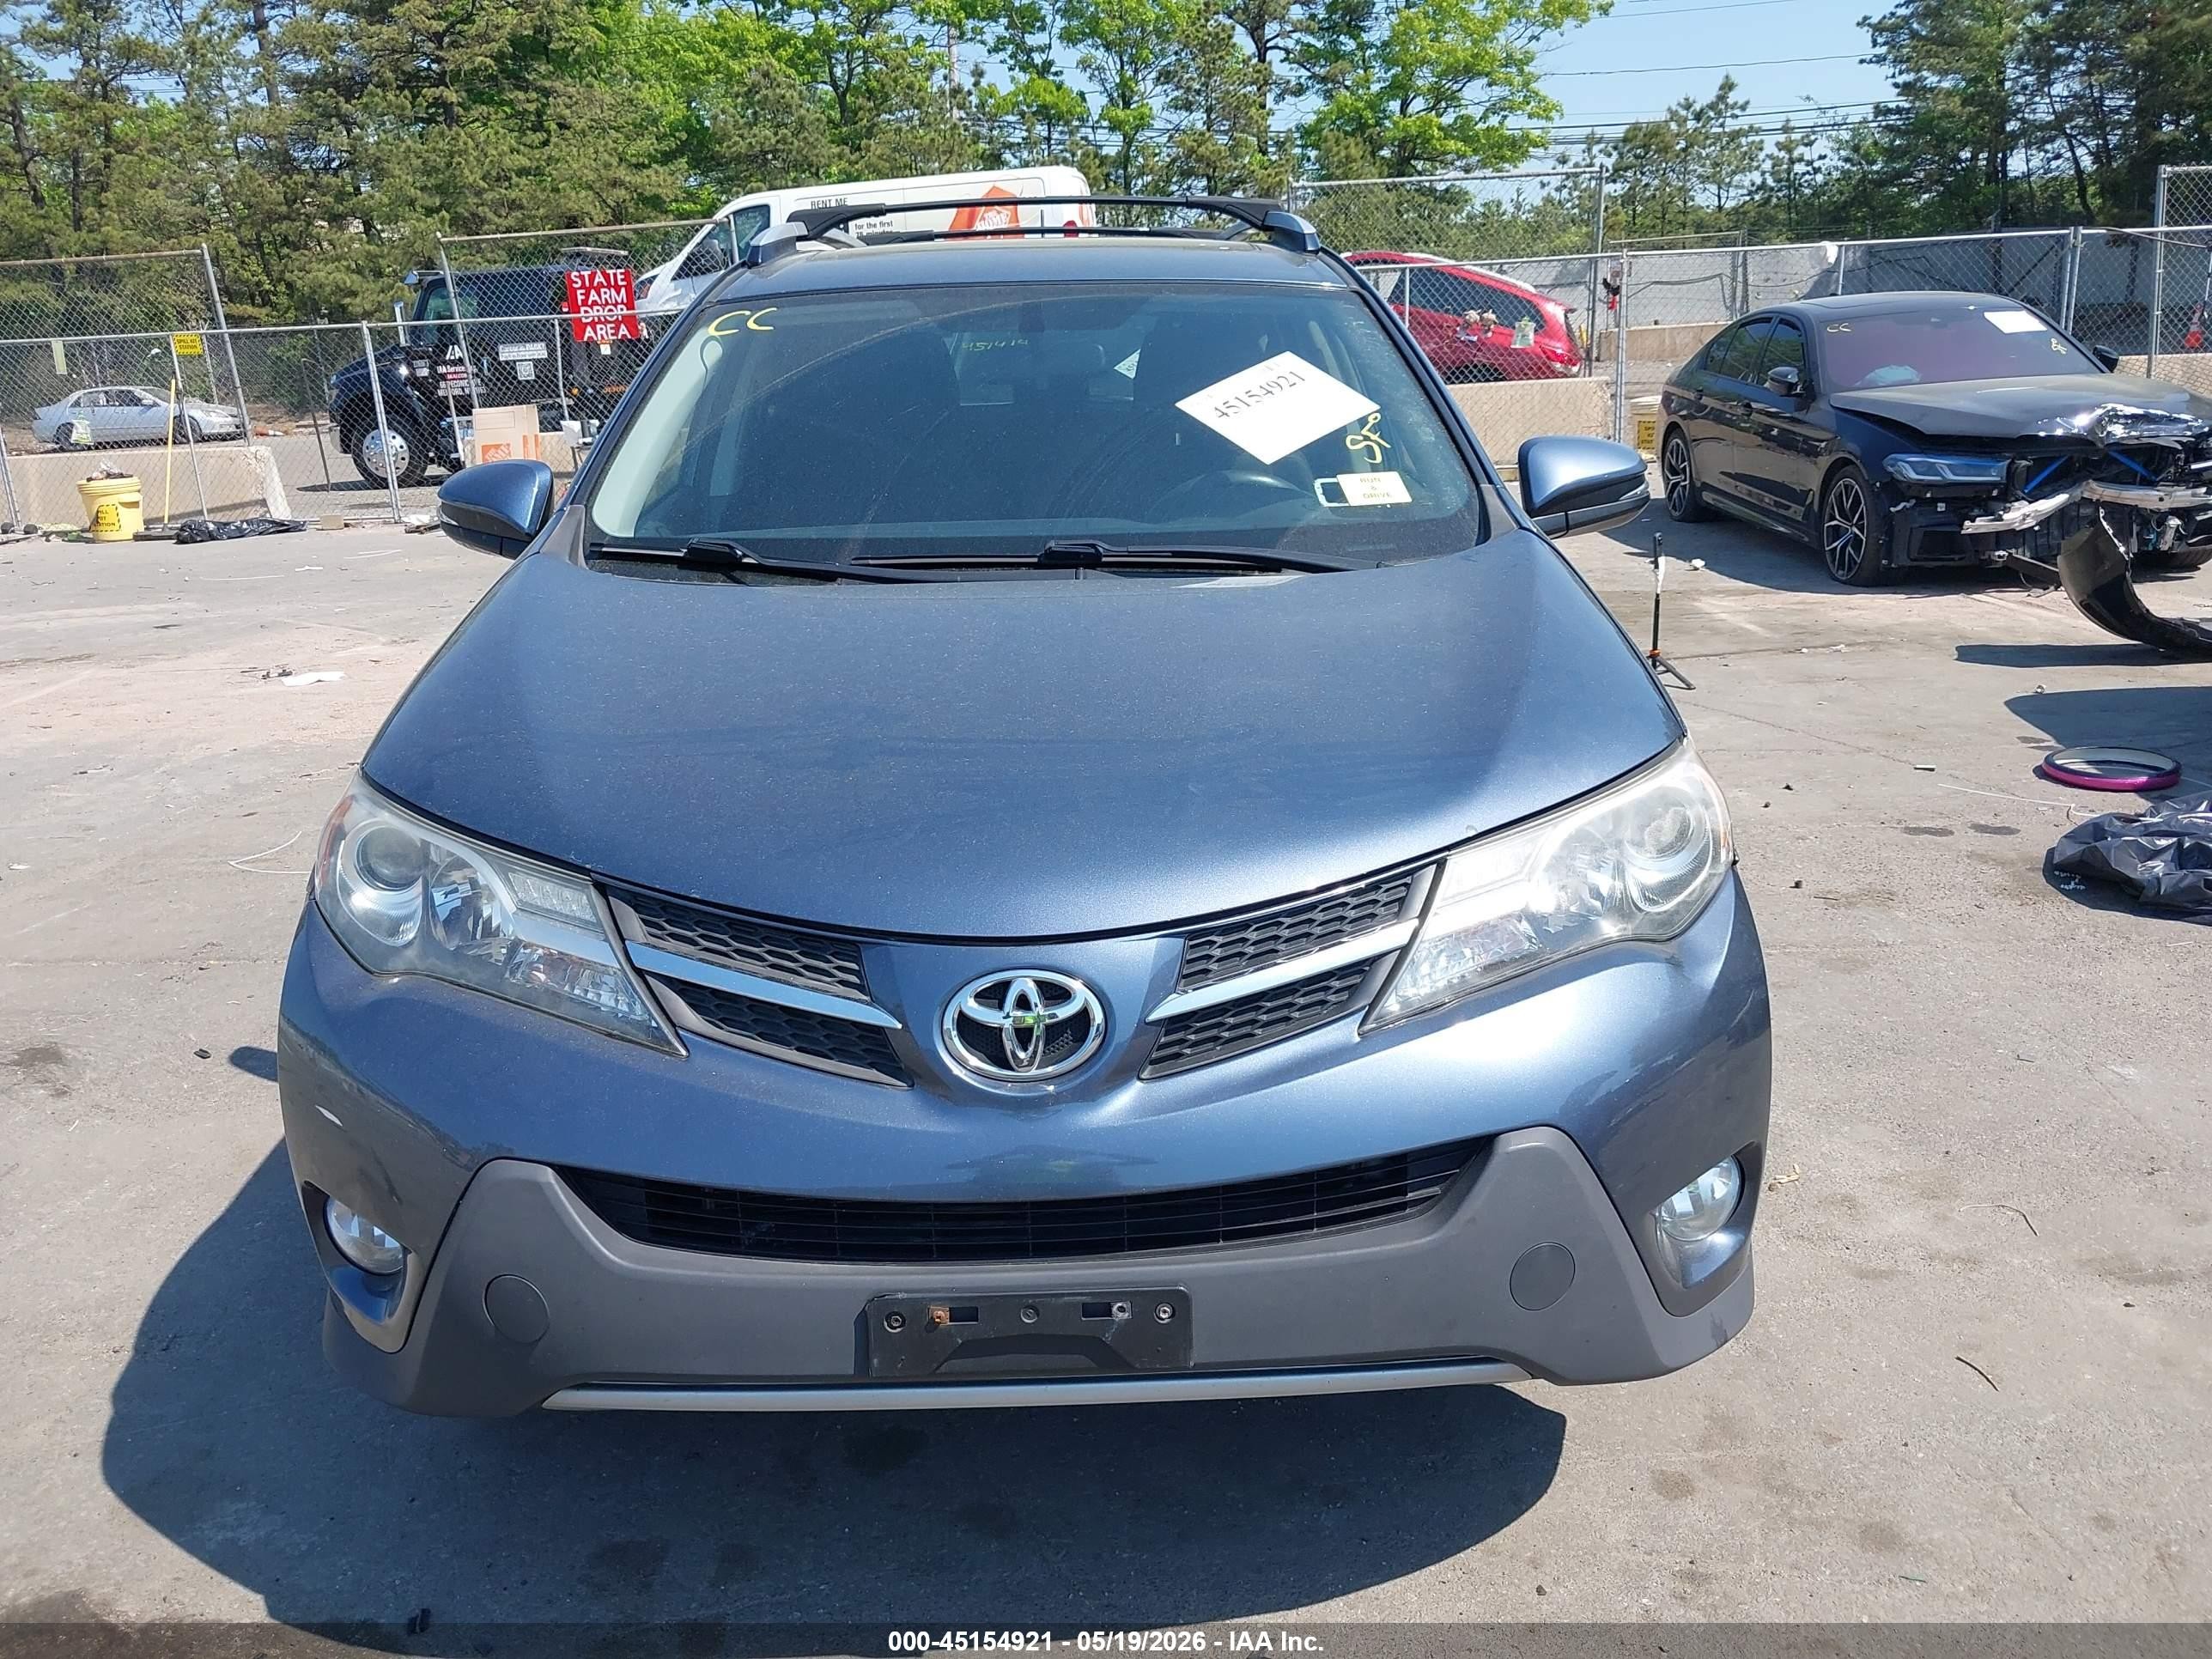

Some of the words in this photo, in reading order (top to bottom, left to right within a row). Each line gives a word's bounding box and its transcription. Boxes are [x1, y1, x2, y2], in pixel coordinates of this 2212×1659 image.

[811, 198, 833, 210] RENT
[835, 198, 848, 207] ME
[878, 220, 894, 228] first
[571, 269, 627, 288] STATE
[576, 287, 628, 306] FARM
[580, 304, 628, 323] DROP
[707, 307, 778, 337] CC
[583, 323, 631, 341] AREA
[1214, 371, 1306, 418] 45154921
